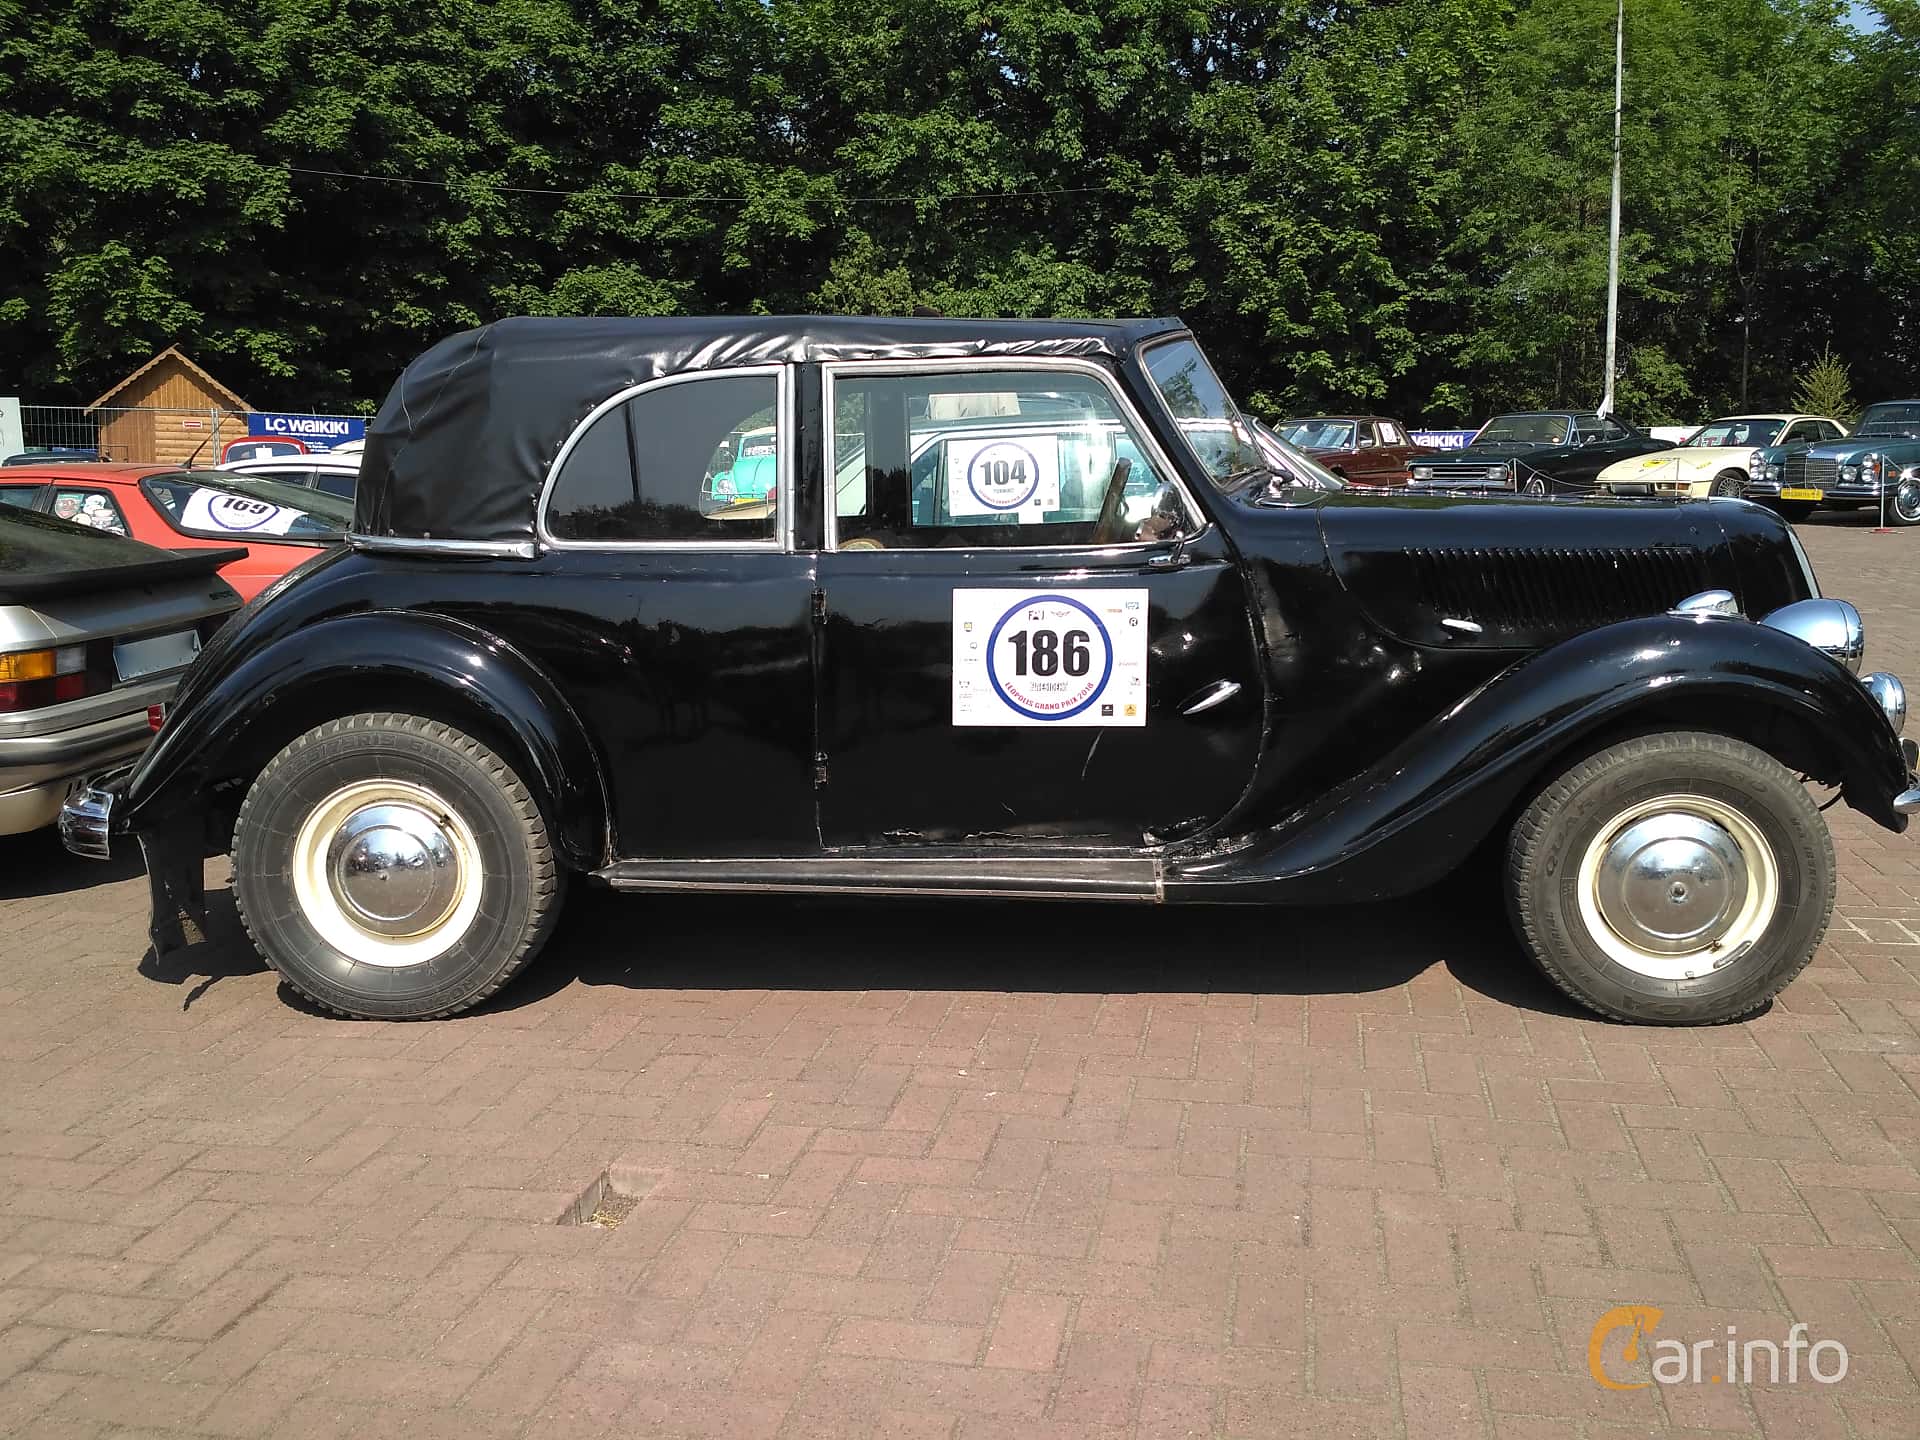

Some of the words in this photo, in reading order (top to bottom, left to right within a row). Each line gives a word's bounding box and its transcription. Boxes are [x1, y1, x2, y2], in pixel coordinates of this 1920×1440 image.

[265, 417, 286, 431] LC
[980, 459, 1027, 486] 104
[223, 497, 268, 515] 169
[1008, 629, 1090, 677] 186
[1005, 682, 1034, 707] LEOPOLIS
[1034, 702, 1060, 710] GRAND
[1061, 696, 1078, 709] PRIX
[1077, 682, 1094, 700] 2018
